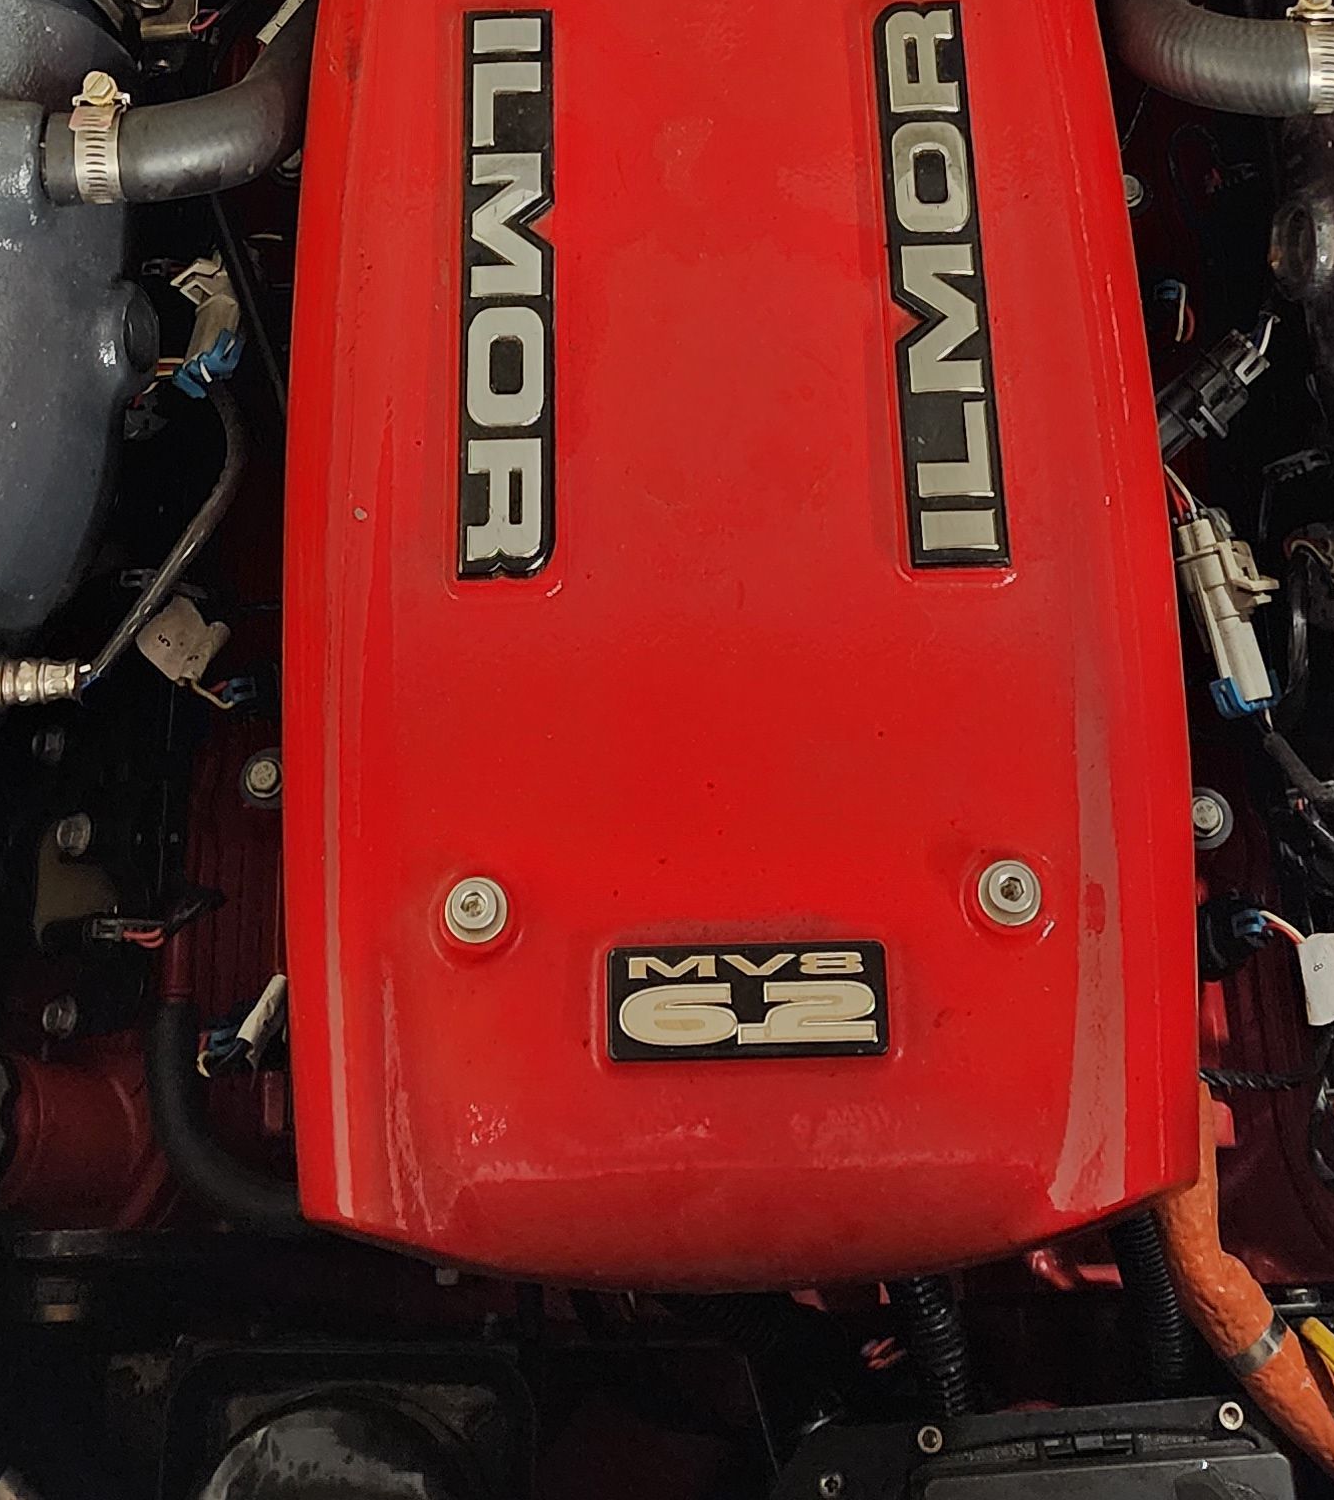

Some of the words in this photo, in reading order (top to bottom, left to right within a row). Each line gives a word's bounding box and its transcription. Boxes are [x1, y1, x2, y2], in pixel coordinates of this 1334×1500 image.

[466, 17, 546, 562] ILMOR
[884, 7, 1000, 551] ILMOR
[628, 951, 865, 980] MV8
